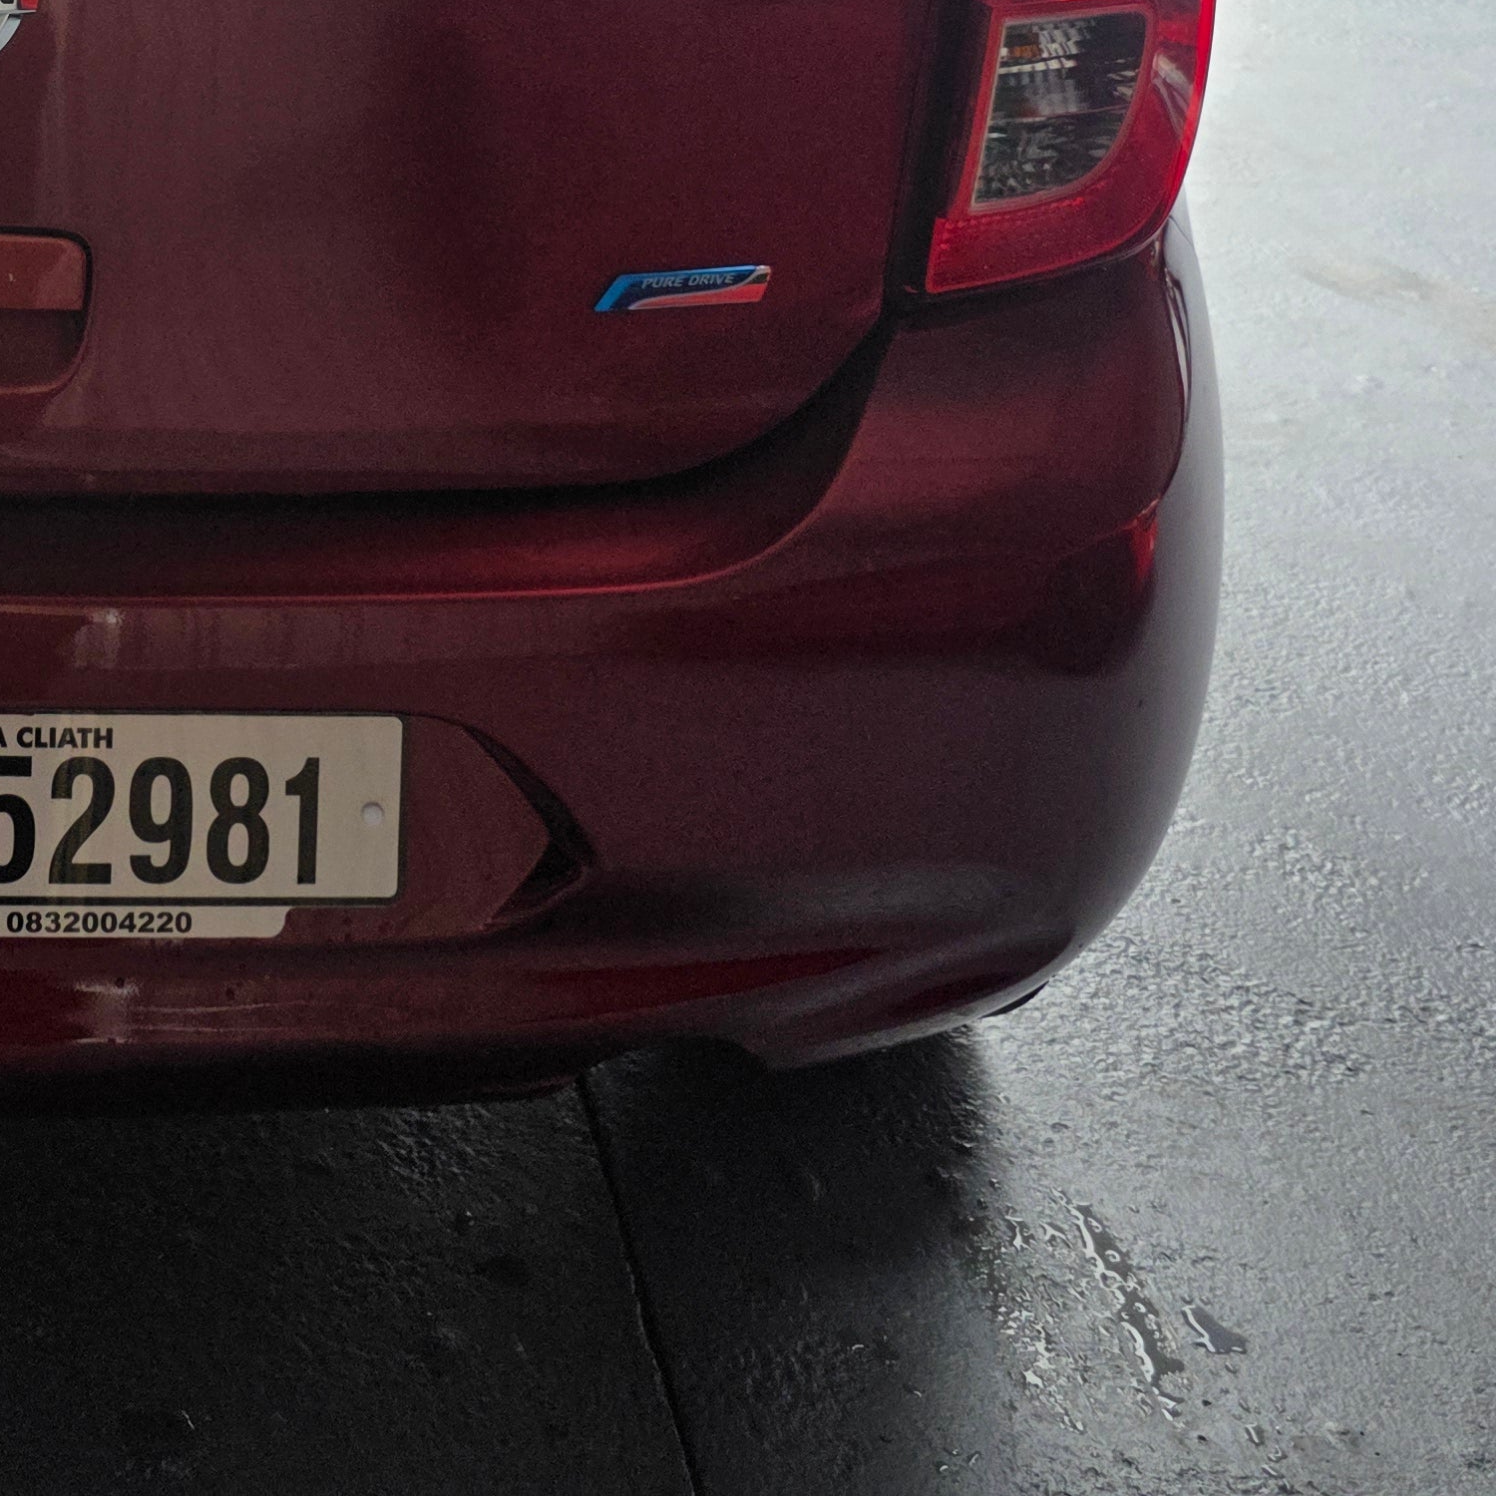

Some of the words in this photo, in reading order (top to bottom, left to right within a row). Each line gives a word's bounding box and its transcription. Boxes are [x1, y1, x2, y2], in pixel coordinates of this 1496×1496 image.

[641, 276, 685, 289] PURE
[688, 272, 736, 287] DRIVE
[15, 725, 114, 750] CLIATH
[5, 910, 193, 935] 0832004220
